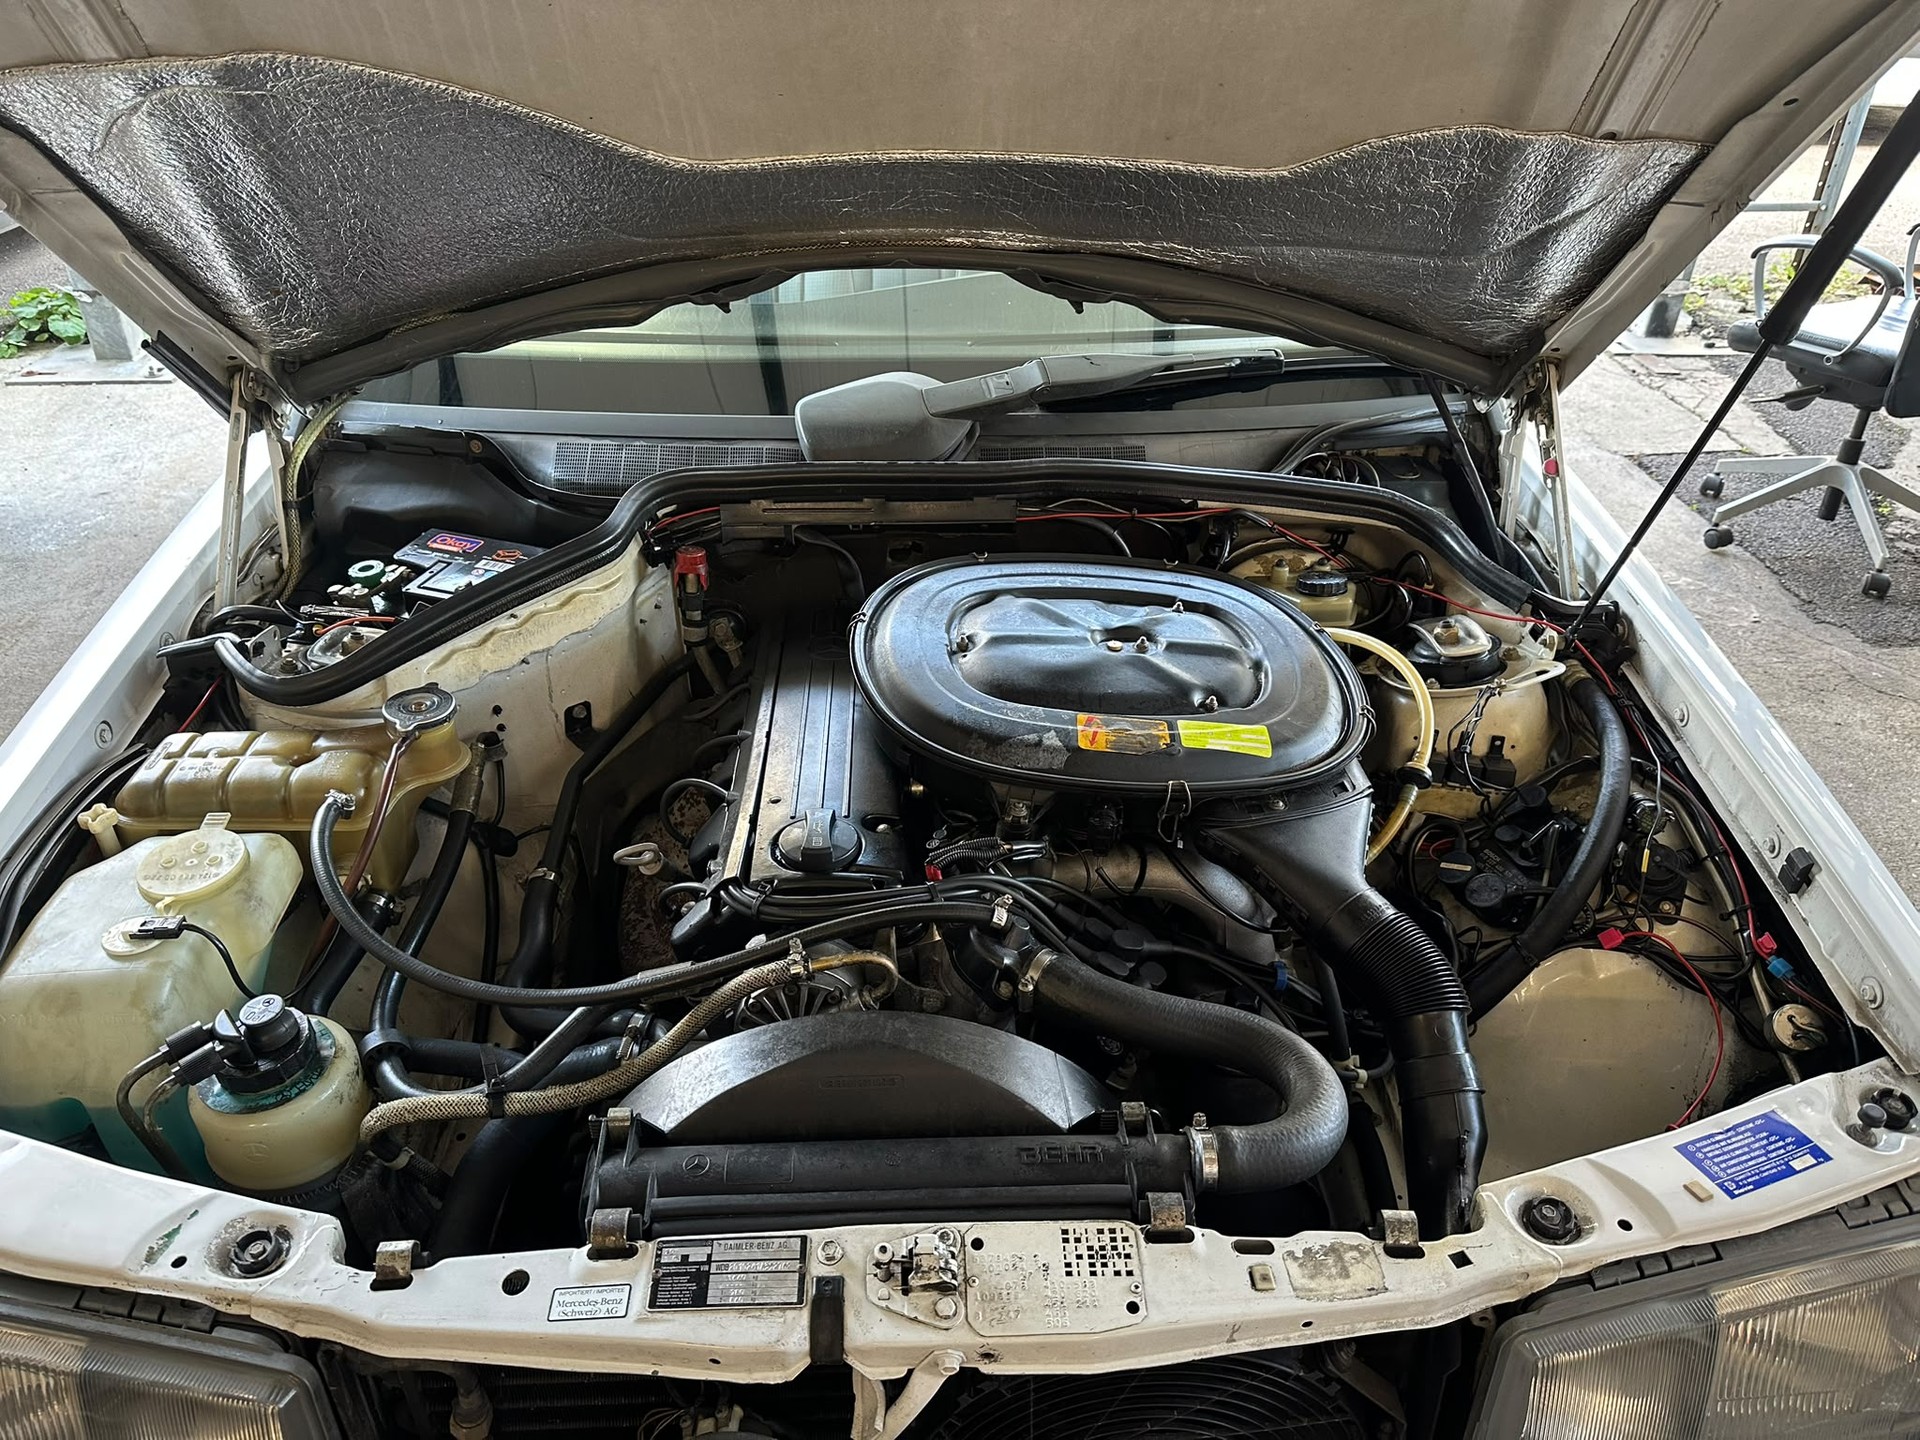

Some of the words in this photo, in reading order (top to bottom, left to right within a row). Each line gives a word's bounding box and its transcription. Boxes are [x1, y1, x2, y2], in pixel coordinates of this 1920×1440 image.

[436, 536, 477, 549] Okay
[1018, 1144, 1104, 1165] BEHR
[723, 1241, 775, 1251] DAIMLER-BENZ
[556, 1297, 623, 1308] Mercedes-Benz
[558, 1307, 602, 1318] (Schweiz)
[603, 1306, 618, 1315] AG
